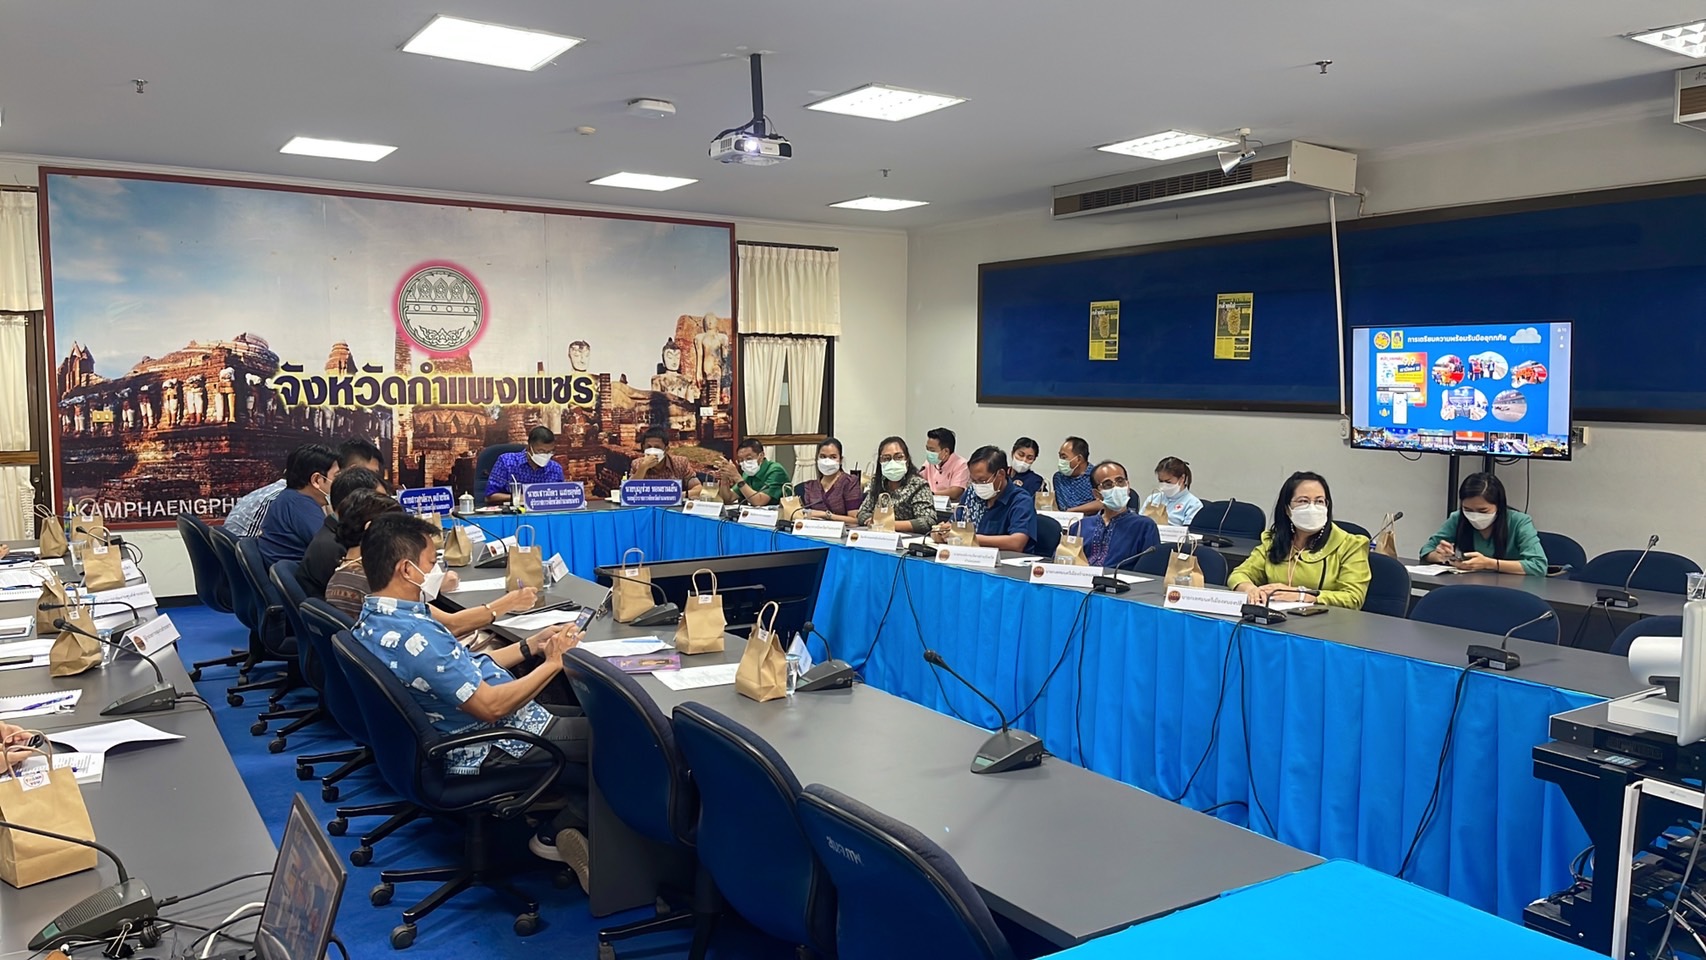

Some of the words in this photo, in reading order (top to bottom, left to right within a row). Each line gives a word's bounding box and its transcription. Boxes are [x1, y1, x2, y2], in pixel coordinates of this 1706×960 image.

[273, 362, 594, 404] จังหวัดกำแพงเพชร
[76, 498, 240, 518] KAMPHAENGPH
